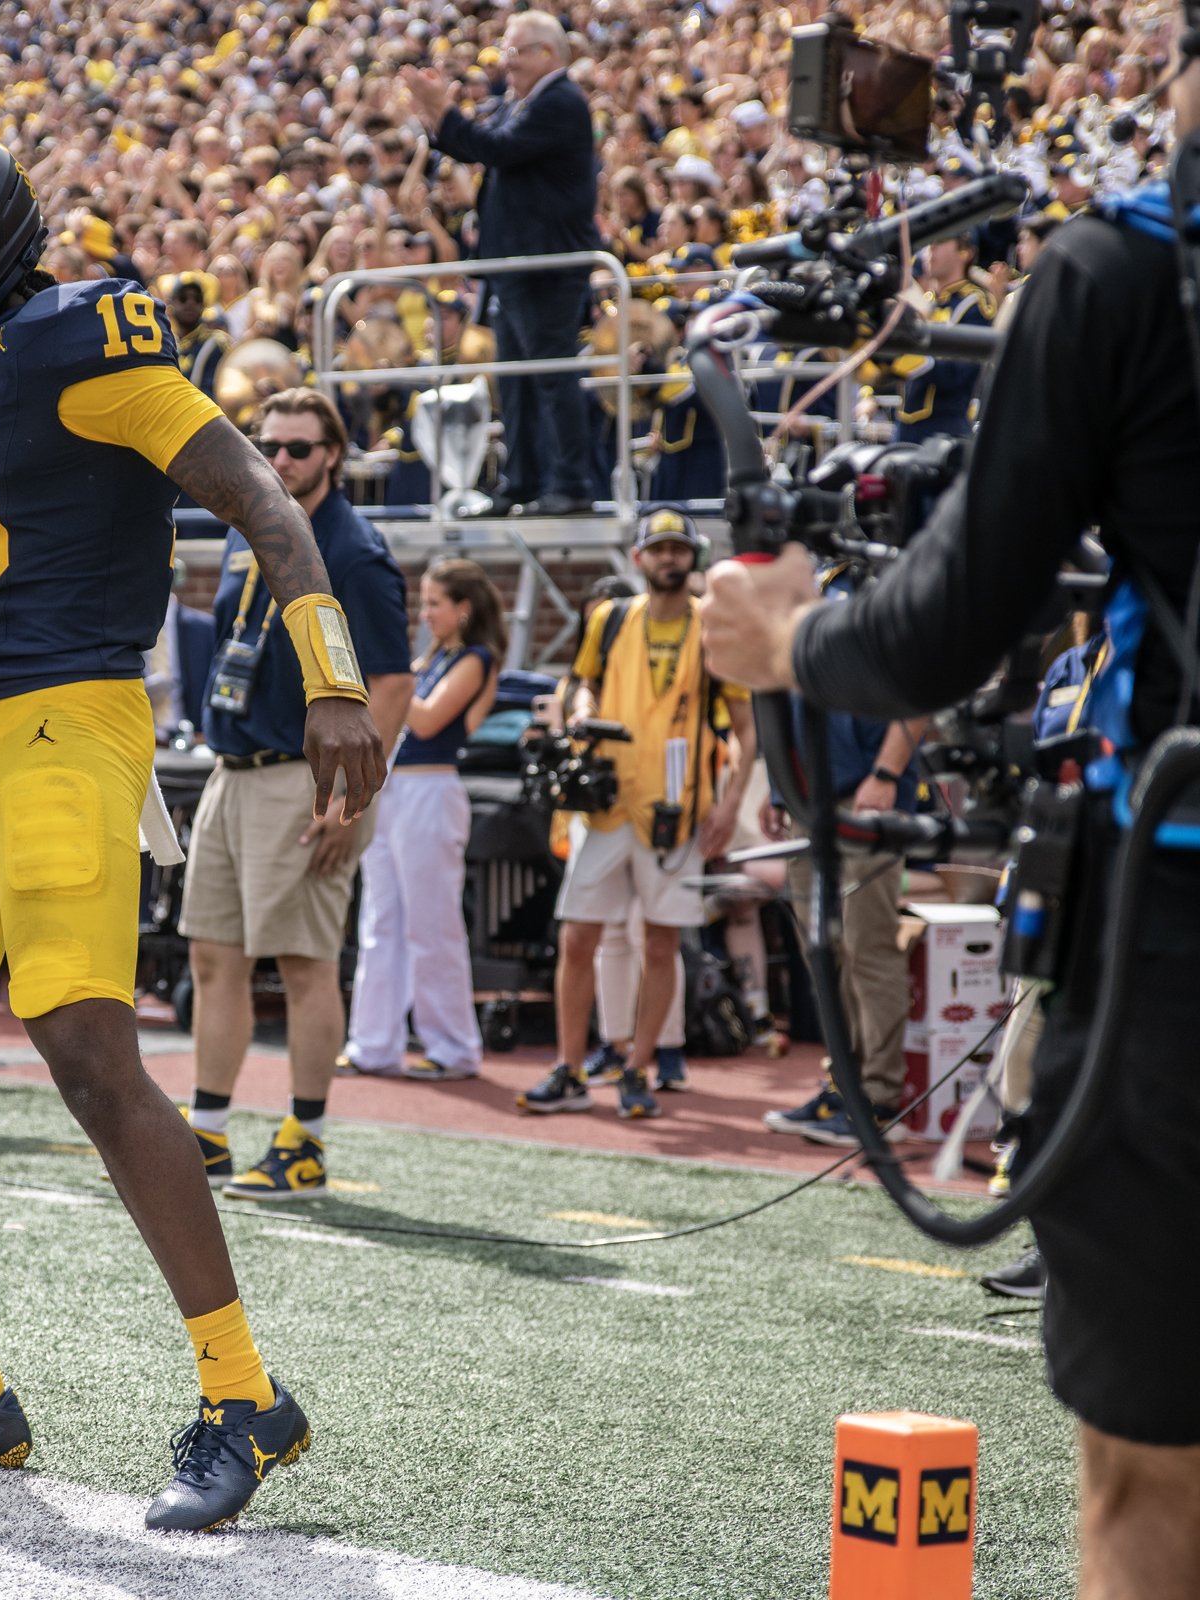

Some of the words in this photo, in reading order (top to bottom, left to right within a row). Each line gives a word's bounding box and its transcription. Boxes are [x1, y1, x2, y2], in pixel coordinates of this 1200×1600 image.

[96, 293, 162, 357] 19
[203, 1408, 225, 1426] M
[842, 1470, 899, 1535] M
[920, 1478, 970, 1536] M
